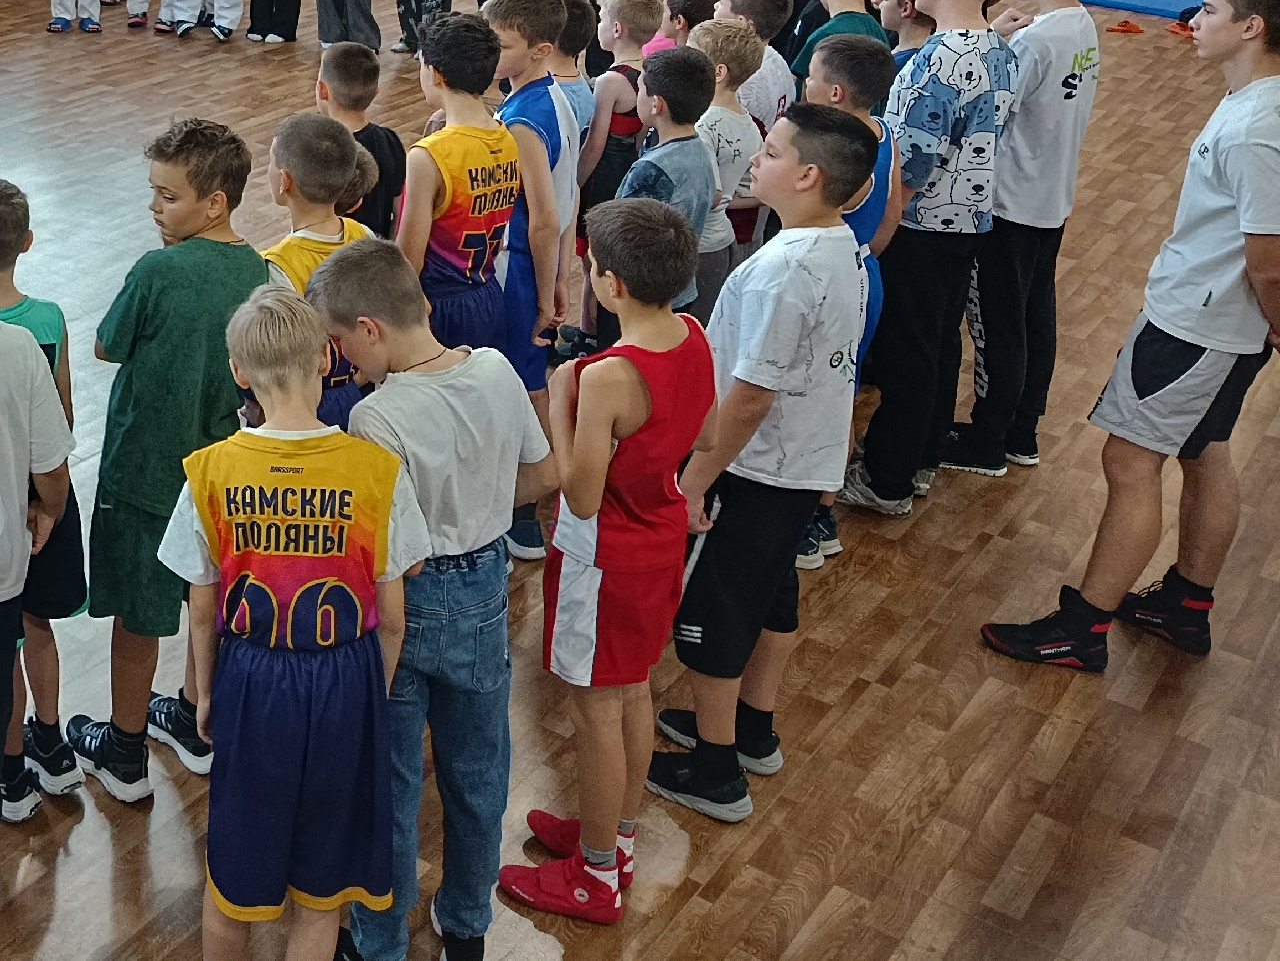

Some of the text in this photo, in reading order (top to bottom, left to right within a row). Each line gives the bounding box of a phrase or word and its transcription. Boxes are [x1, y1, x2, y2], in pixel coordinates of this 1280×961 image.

[467, 158, 518, 191] КАМСКИ
[225, 485, 354, 521] КАМСКИЕ
[233, 521, 347, 555] ПОЛЯНЫ
